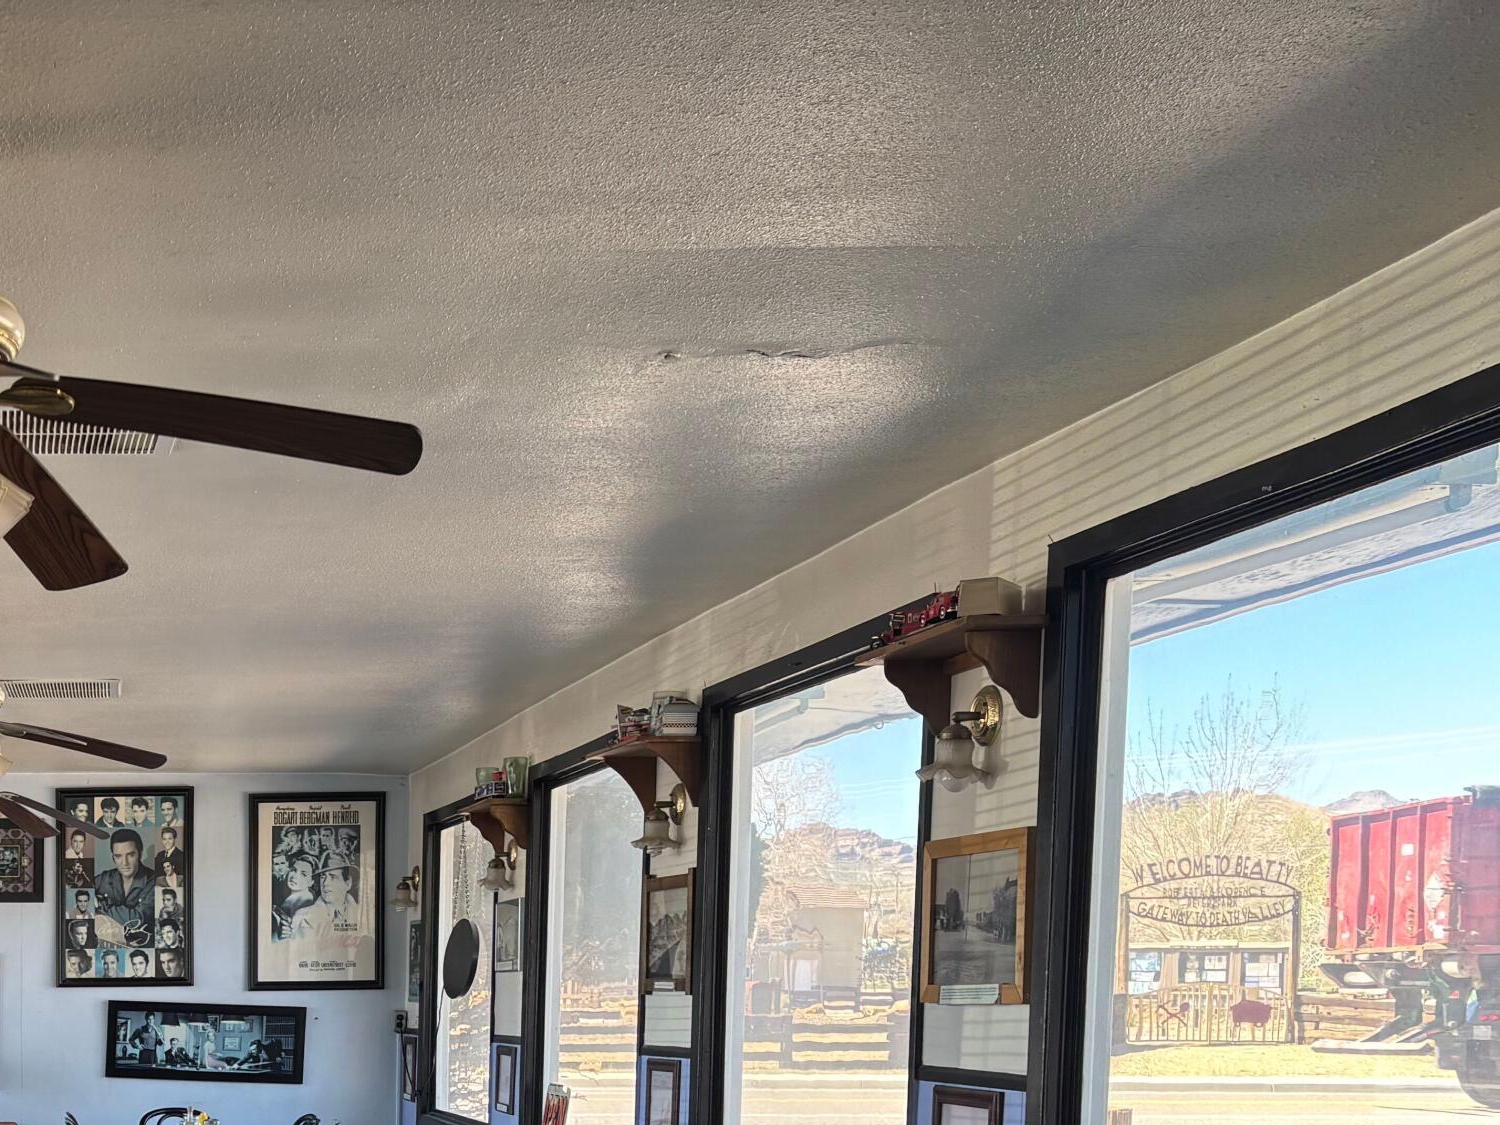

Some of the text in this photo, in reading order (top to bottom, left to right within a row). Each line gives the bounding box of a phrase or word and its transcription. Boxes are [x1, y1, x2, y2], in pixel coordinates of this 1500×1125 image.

[274, 810, 359, 825] BOGART BERGMAN HENREID
[1133, 854, 1294, 886] WELCOME TO BEATTY
[1137, 900, 1286, 926] GATEWAY TO DEATH VALLEY
